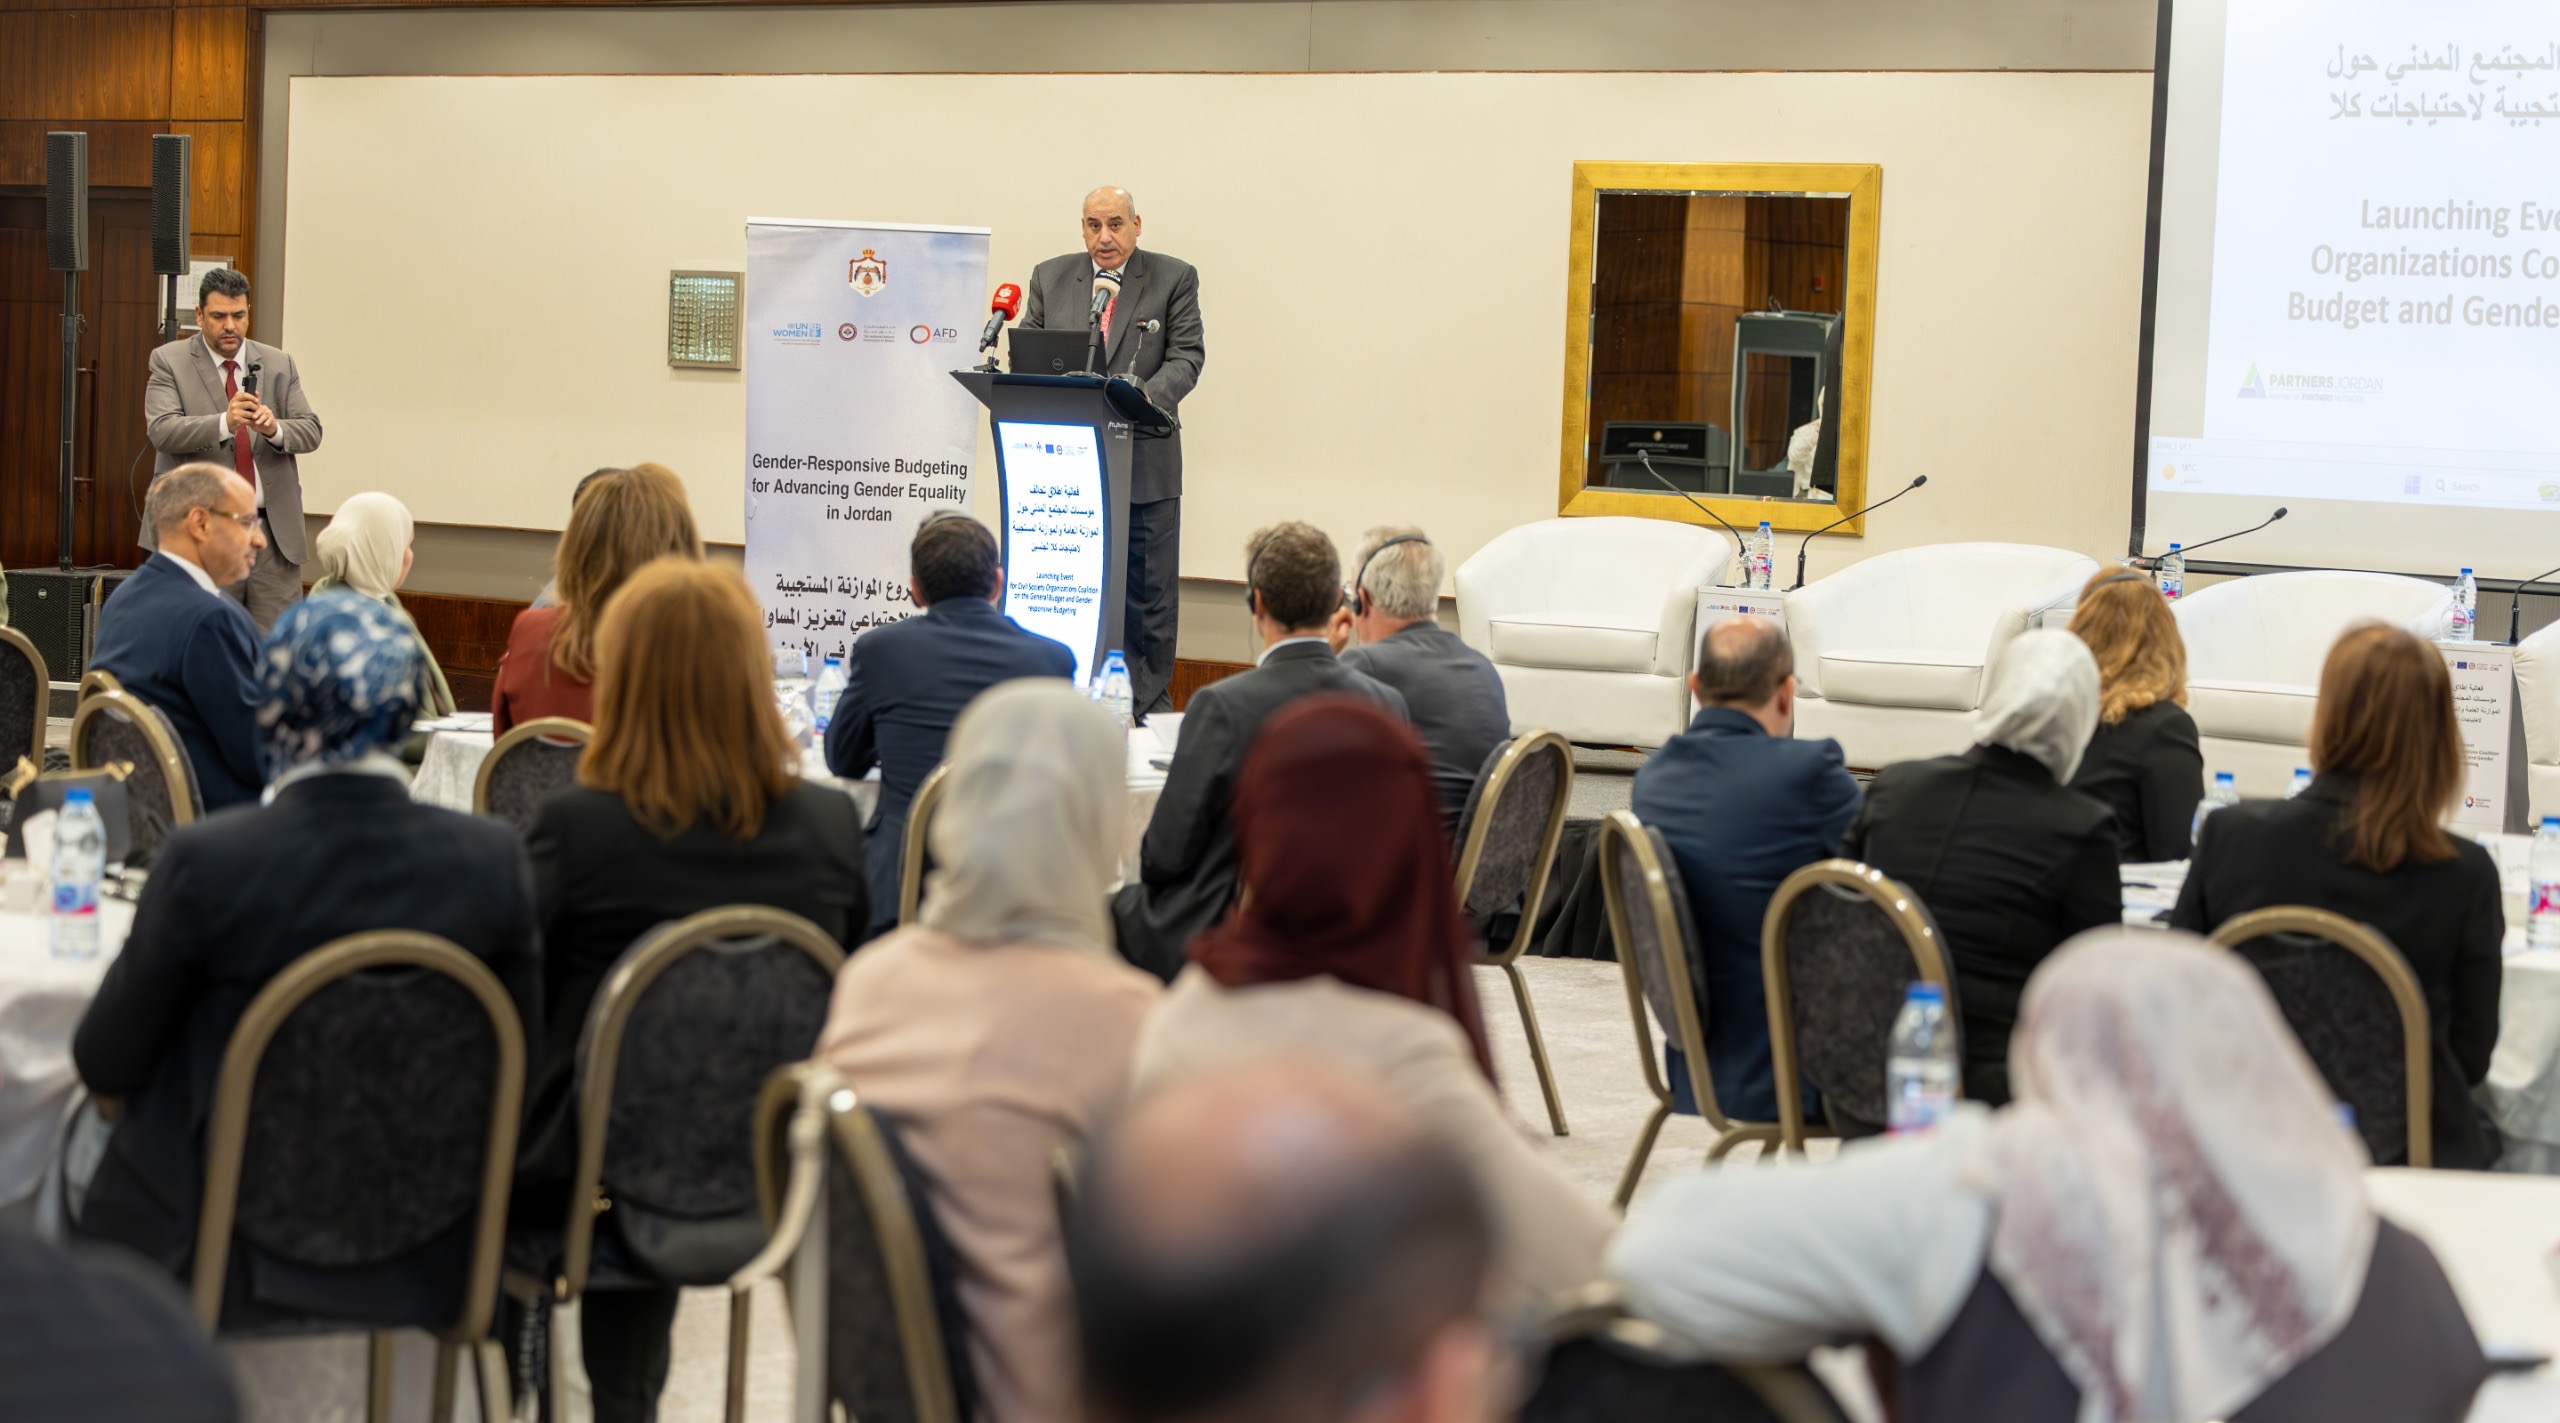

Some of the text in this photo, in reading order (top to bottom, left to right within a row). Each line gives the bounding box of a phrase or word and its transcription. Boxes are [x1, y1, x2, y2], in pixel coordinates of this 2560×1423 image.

[2326, 42, 2378, 80] حول
[2385, 43, 2460, 86] المدني
[2328, 90, 2362, 120] كلا
[2370, 91, 2485, 127] لاحتياجات
[2360, 198, 2511, 238] Launching
[2311, 244, 2559, 283] Organizations Co
[2287, 291, 2559, 330] Budget and Gende
[773, 329, 808, 337] WOMEN
[933, 328, 957, 338] AFD
[752, 453, 968, 480] Gender-Responsive Budgeting
[751, 478, 966, 504] for Advancing Gender Equality
[2452, 481, 2480, 493] Search
[827, 505, 892, 522] in Jordan
[776, 573, 833, 598] المستجيبة
[837, 576, 882, 600] الموازنة
[1009, 581, 1099, 594] for Civil Society Organizations Coalition
[1036, 572, 1074, 581] Launching Event
[1021, 592, 1029, 600] the
[1030, 593, 1048, 601] General
[1048, 594, 1065, 603] Budget
[762, 607, 800, 628] المساوا
[802, 608, 847, 631] لتعزيز
[1028, 605, 1077, 616] responsive Budgeting
